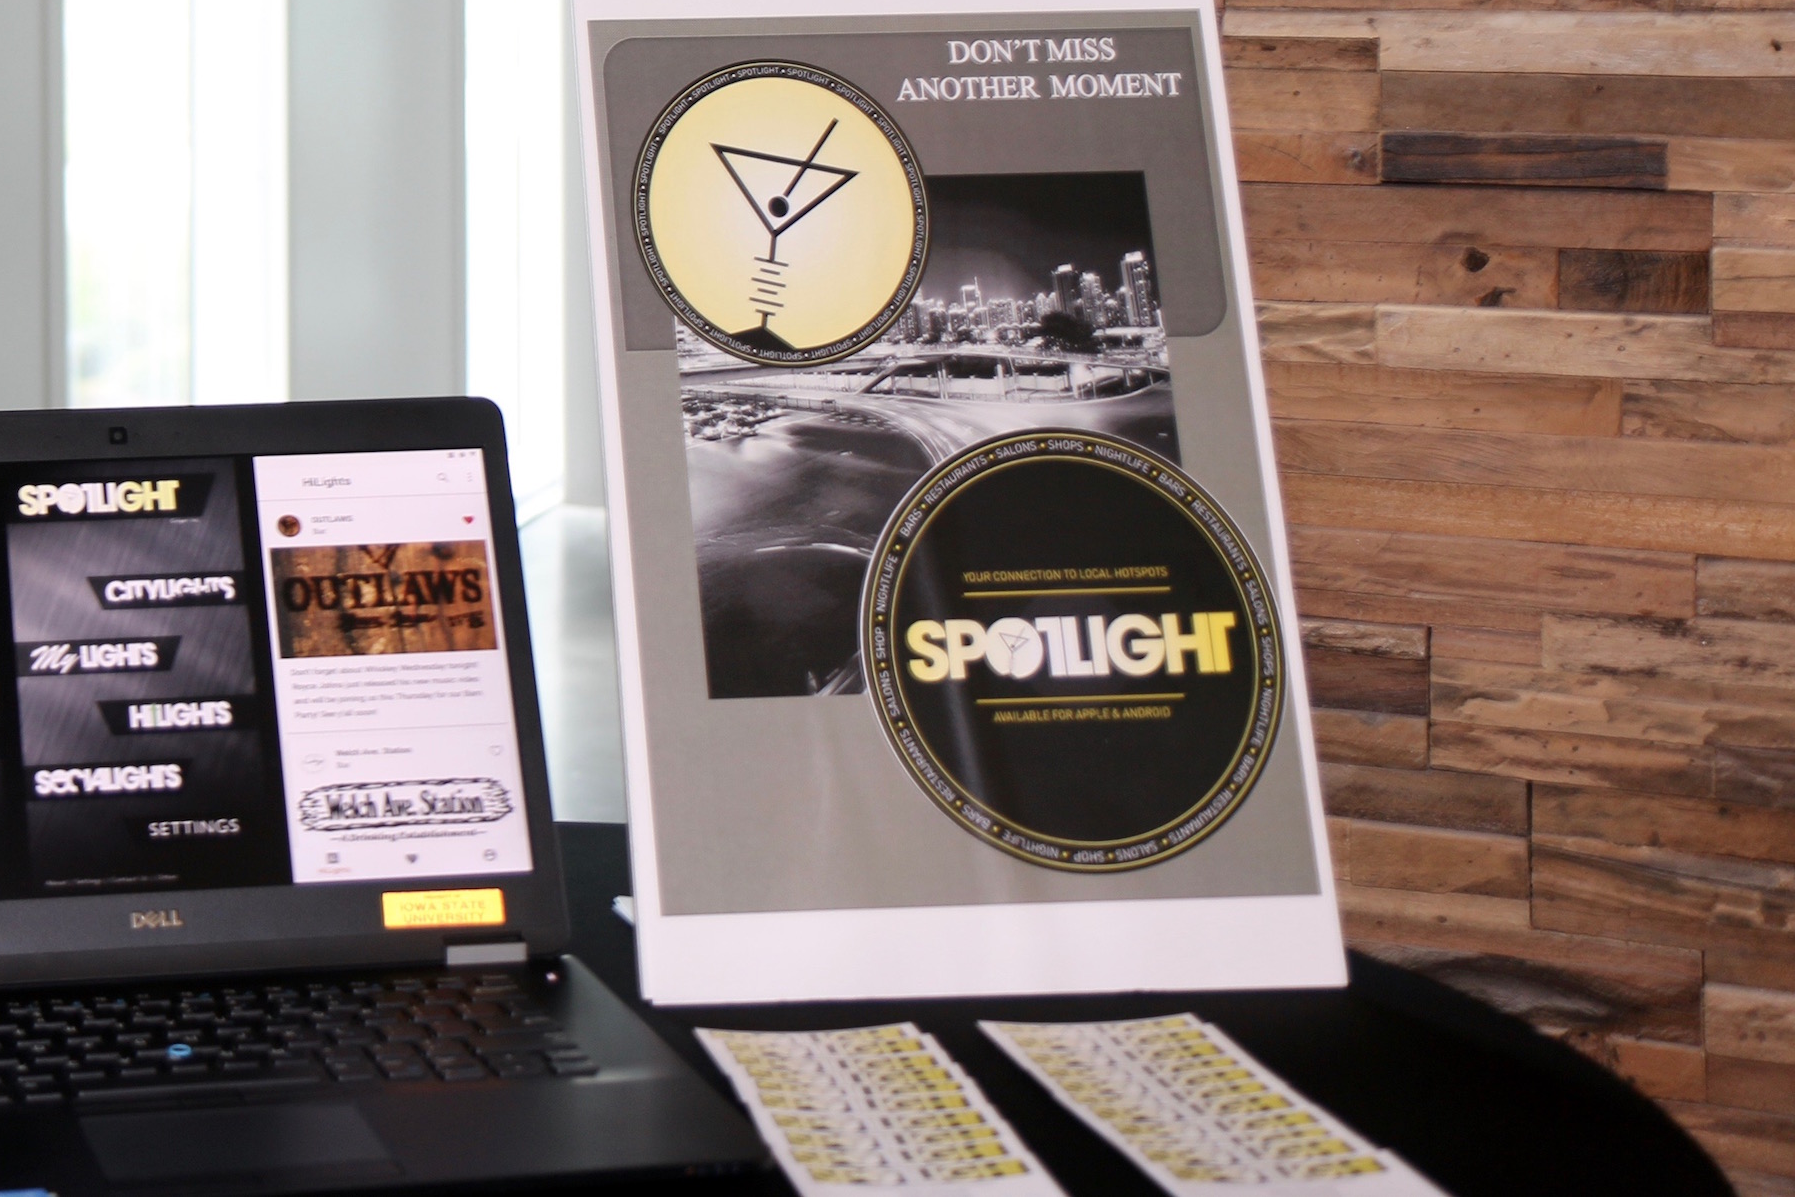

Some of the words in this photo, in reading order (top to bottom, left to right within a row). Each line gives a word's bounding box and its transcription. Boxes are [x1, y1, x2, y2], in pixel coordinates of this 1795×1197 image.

[947, 39, 1041, 65] DON'T
[1044, 37, 1117, 63] MISS
[691, 74, 731, 99] SPOTLIGHT
[736, 66, 780, 79] SPOTLIGHT
[787, 68, 829, 84] SPOTLIGHT
[896, 74, 1041, 102] ANOTHER
[1049, 72, 1183, 100] MOMENT
[836, 84, 874, 115] SPOTLIGHT
[658, 99, 689, 135] SPOTLIGHT
[877, 117, 907, 157] SPOTLIGHT
[640, 140, 659, 184] SPOTLIGHT
[905, 163, 923, 207] SPOTLIGHT
[637, 191, 650, 237] SPOTLIGHT
[915, 214, 925, 259] SPOTLIGHT
[645, 244, 669, 287] SPOTLIGHT
[893, 266, 918, 306] SPOTLIGHT
[669, 289, 704, 329] SPOTLIGHT
[859, 309, 893, 340] SPOTLIGHT
[709, 328, 751, 353] SPOTLIGHT
[758, 348, 803, 360] SPOTLIGHT
[810, 340, 855, 359] SPOTLIGHT
[994, 440, 1038, 459] SALONS
[1047, 439, 1084, 452] SHOPS
[1094, 444, 1150, 474] NIGHTLIFE
[924, 454, 988, 505] RESTAURANTS
[1157, 472, 1186, 498] BARS
[17, 479, 180, 516] SPOTLIGHT
[899, 508, 923, 537] BARS
[1190, 500, 1247, 572] RESTAURANTS
[104, 575, 236, 600] CITYLIGHTS
[875, 554, 899, 613] NIGHTLIFE
[963, 570, 991, 582] YOUR
[993, 569, 1062, 581] CONNECTION
[1063, 568, 1077, 580] TO
[1078, 567, 1113, 579] LOCAL
[1114, 565, 1169, 578] HOTSPOTS
[282, 568, 484, 612] OUTLAWS
[1245, 579, 1269, 626] SALONS
[29, 643, 80, 674] My
[78, 641, 159, 668] LIGHTS
[875, 626, 887, 659] SHOP
[906, 611, 1237, 683] SPOTLIGHT
[1260, 635, 1276, 677] SHOPS
[879, 670, 900, 718] SALONS
[993, 709, 1051, 723] AVAILABLE
[1052, 708, 1074, 721] FOR
[1075, 707, 1111, 720] APPLE
[1122, 706, 1171, 719] ANDROID
[1250, 687, 1273, 748] NIGHTLIFE
[900, 728, 957, 803] RESTAURANTS
[1231, 754, 1255, 785] BARS
[324, 793, 377, 820] Welch
[419, 788, 486, 815] Station
[961, 804, 991, 831] BARS
[1168, 789, 1232, 844] RESTAURANTS
[148, 817, 241, 837] SETTINGS
[1002, 828, 1060, 859] NIGHTLIFE
[1073, 850, 1105, 864] SHOP
[1114, 840, 1159, 862] SALONS
[130, 909, 184, 929] DELL
[399, 902, 438, 912] IOWA
[443, 899, 486, 910] STATE
[403, 911, 484, 924] UNIVERSITY
